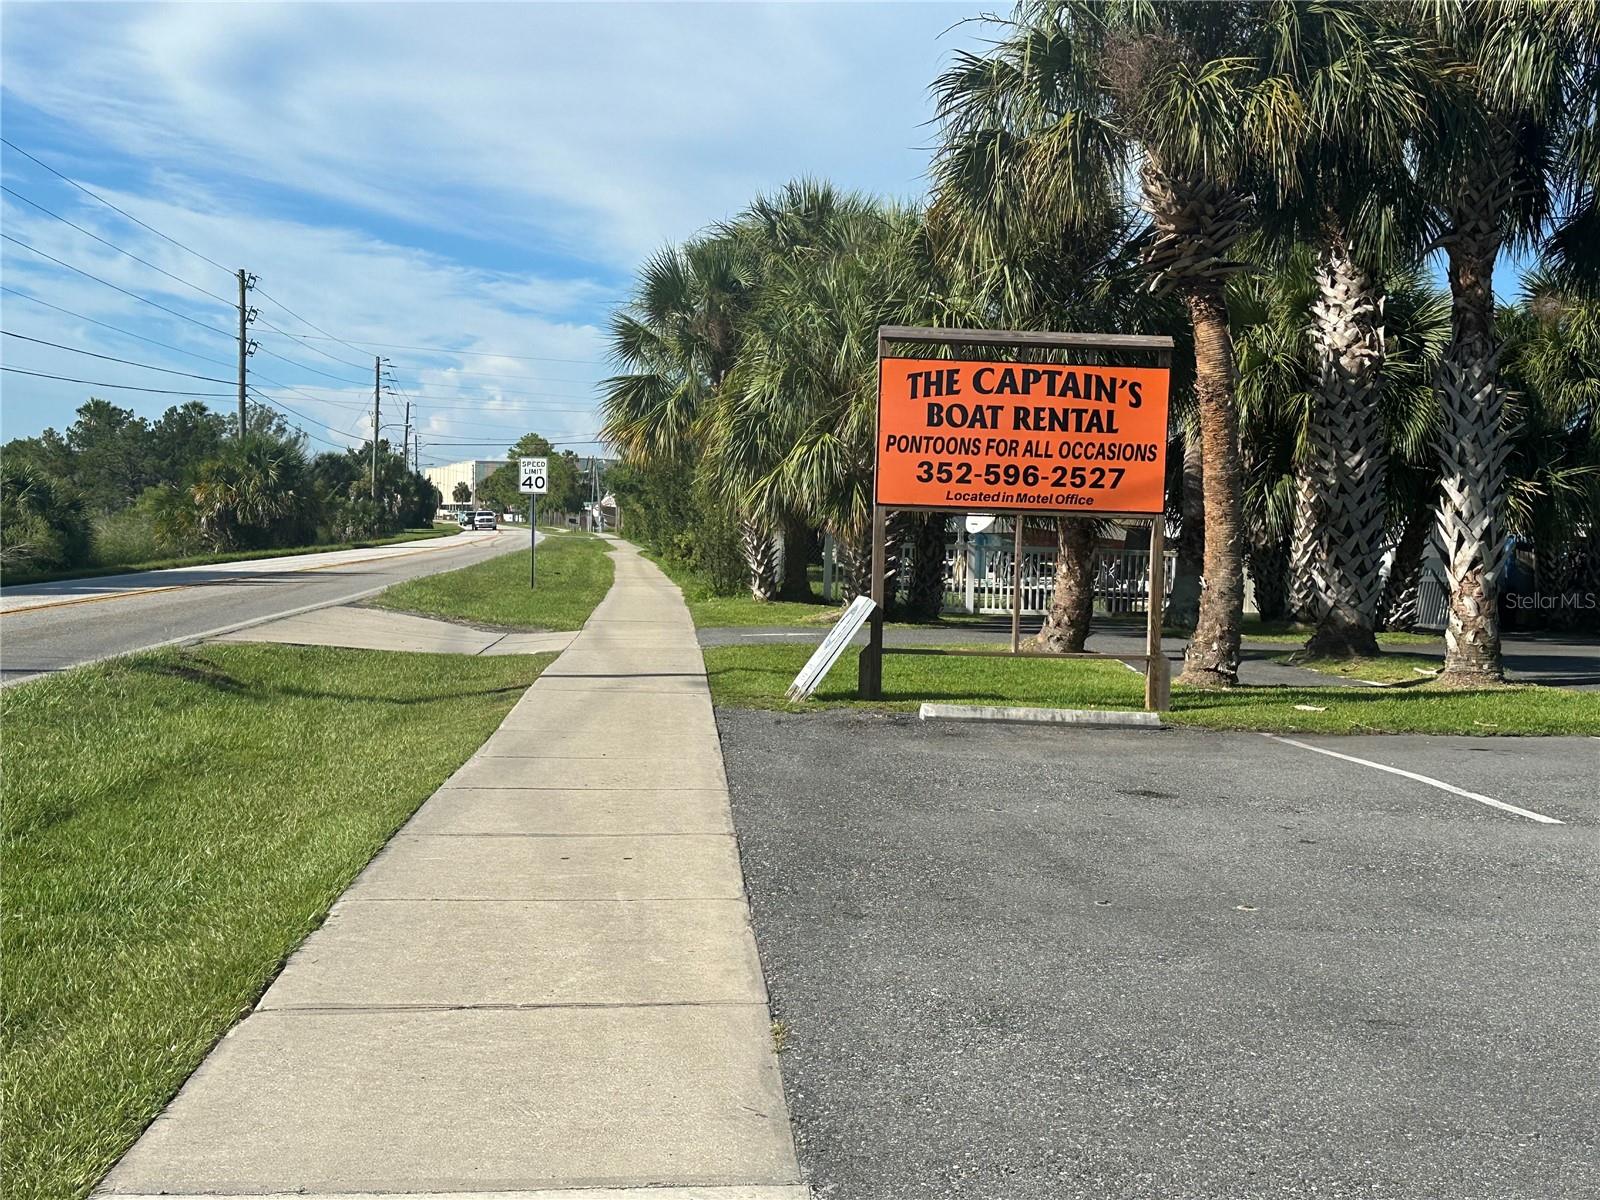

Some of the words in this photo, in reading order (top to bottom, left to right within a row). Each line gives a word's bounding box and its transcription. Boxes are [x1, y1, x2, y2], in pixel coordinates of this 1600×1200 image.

[906, 368, 961, 400] THE
[972, 367, 1143, 409] CAPTAIN'S
[926, 402, 1004, 429] BOAT
[1012, 405, 1119, 434] RENTAL
[885, 434, 981, 456] PONTOONS
[985, 438, 1018, 458] FOR
[1022, 440, 1054, 459] ALL
[1058, 441, 1158, 462] OCCASIONS
[521, 476, 545, 489] 40
[916, 461, 1126, 490] 352-596-2527
[945, 490, 1001, 503] Located
[1001, 492, 1014, 503] in
[1015, 492, 1054, 505] Motel
[1054, 493, 1094, 506] Office
